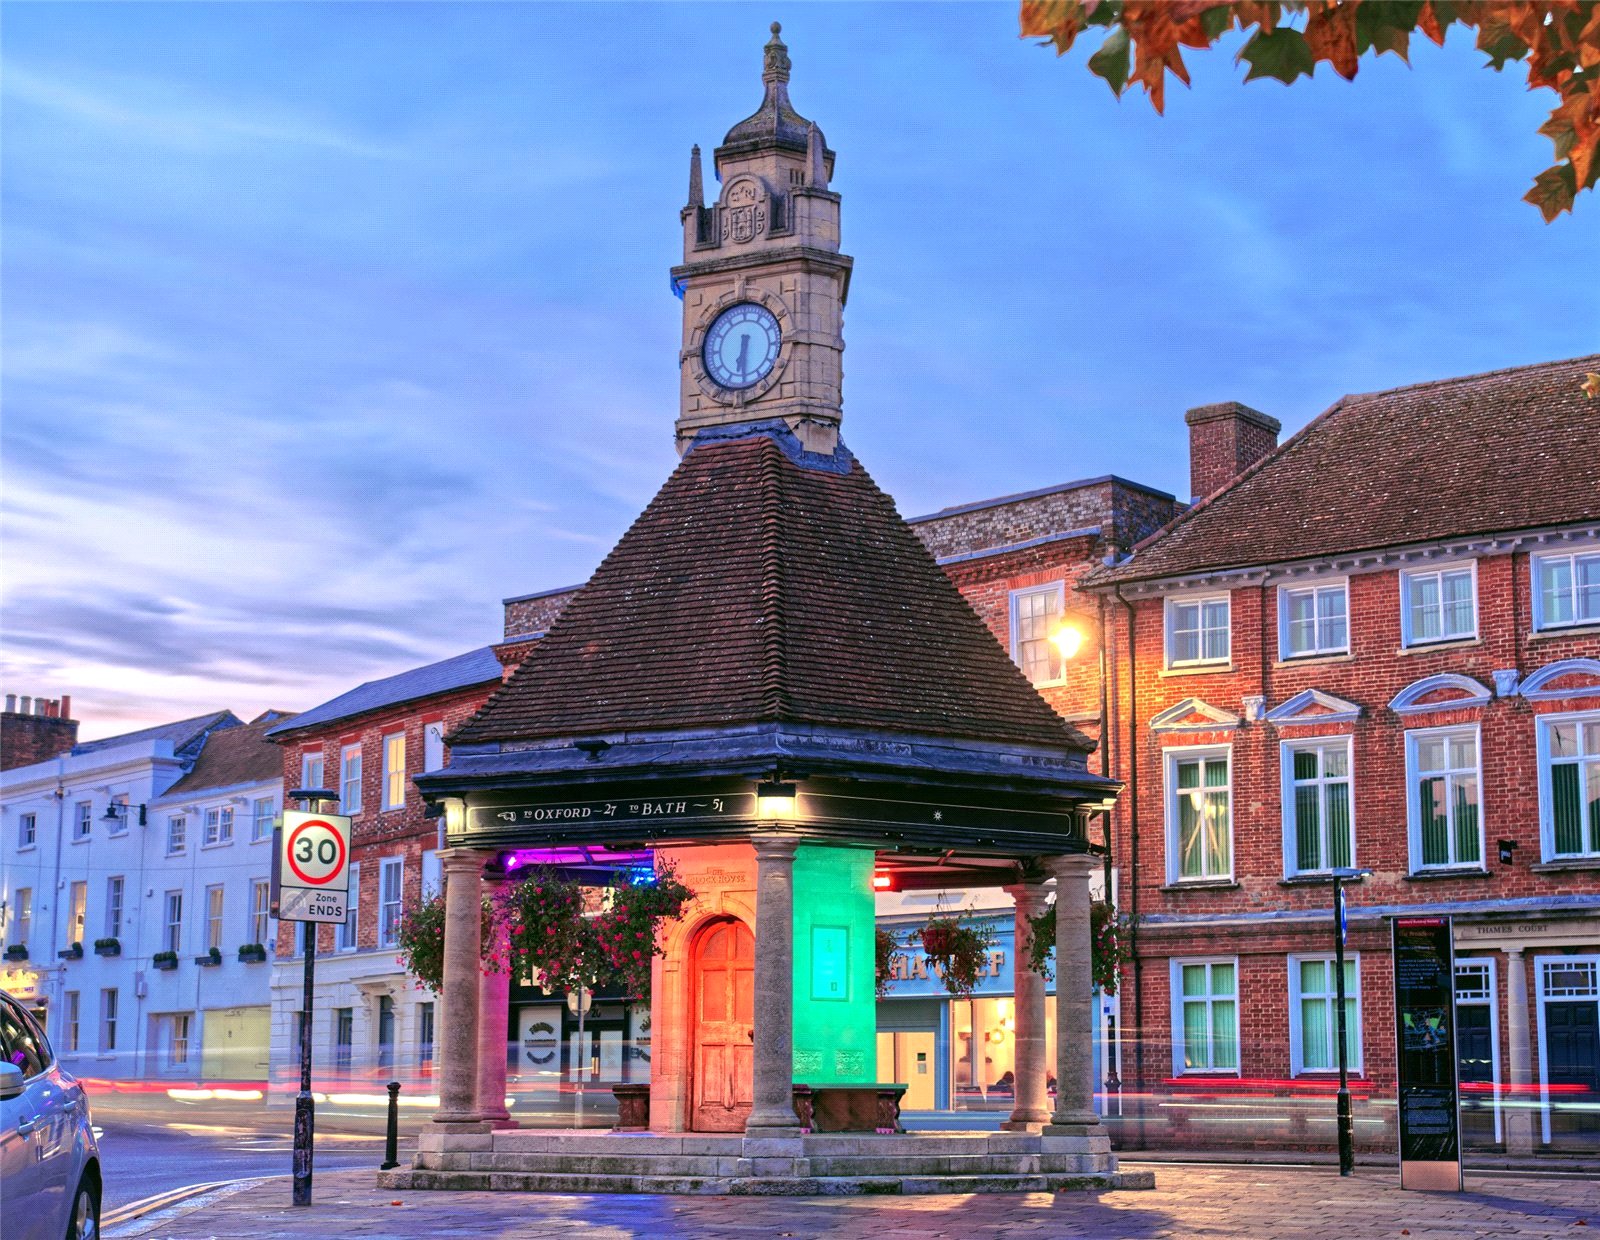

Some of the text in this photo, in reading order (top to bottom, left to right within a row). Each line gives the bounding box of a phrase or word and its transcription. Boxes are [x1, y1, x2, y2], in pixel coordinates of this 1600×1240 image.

[534, 802, 591, 820] OXFORD
[603, 803, 617, 816] 27
[641, 801, 687, 815] BATH
[296, 836, 337, 865] 30
[316, 893, 337, 903] Zone
[308, 904, 342, 917] ENDS
[1476, 924, 1548, 934] THAMES COURT
